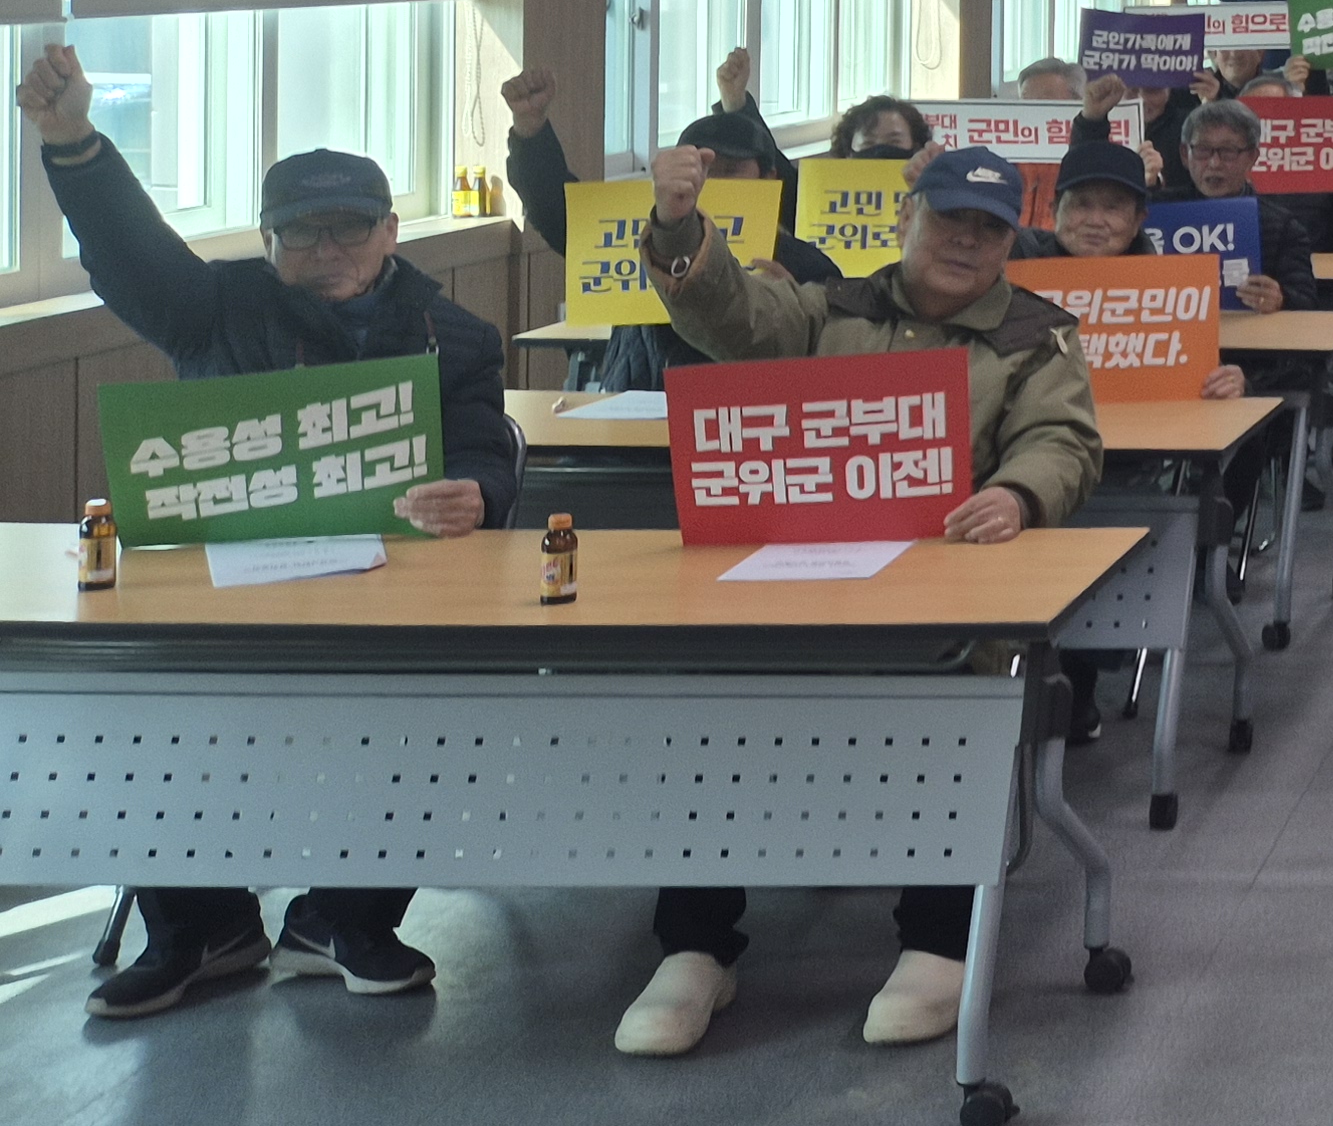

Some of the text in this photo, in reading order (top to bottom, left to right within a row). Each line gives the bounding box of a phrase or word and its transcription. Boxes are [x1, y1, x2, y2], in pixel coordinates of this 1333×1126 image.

[1081, 49, 1137, 72] 군위가
[966, 117, 1040, 146] 군민의
[819, 189, 884, 216] 고민
[1171, 222, 1236, 253] OK!
[579, 258, 652, 295] 군위
[129, 380, 415, 478] 수용성 최고!
[692, 391, 947, 454] 대구 군부대
[144, 433, 429, 522] 작전성 최고!
[690, 445, 954, 507] 군위군 이전!
